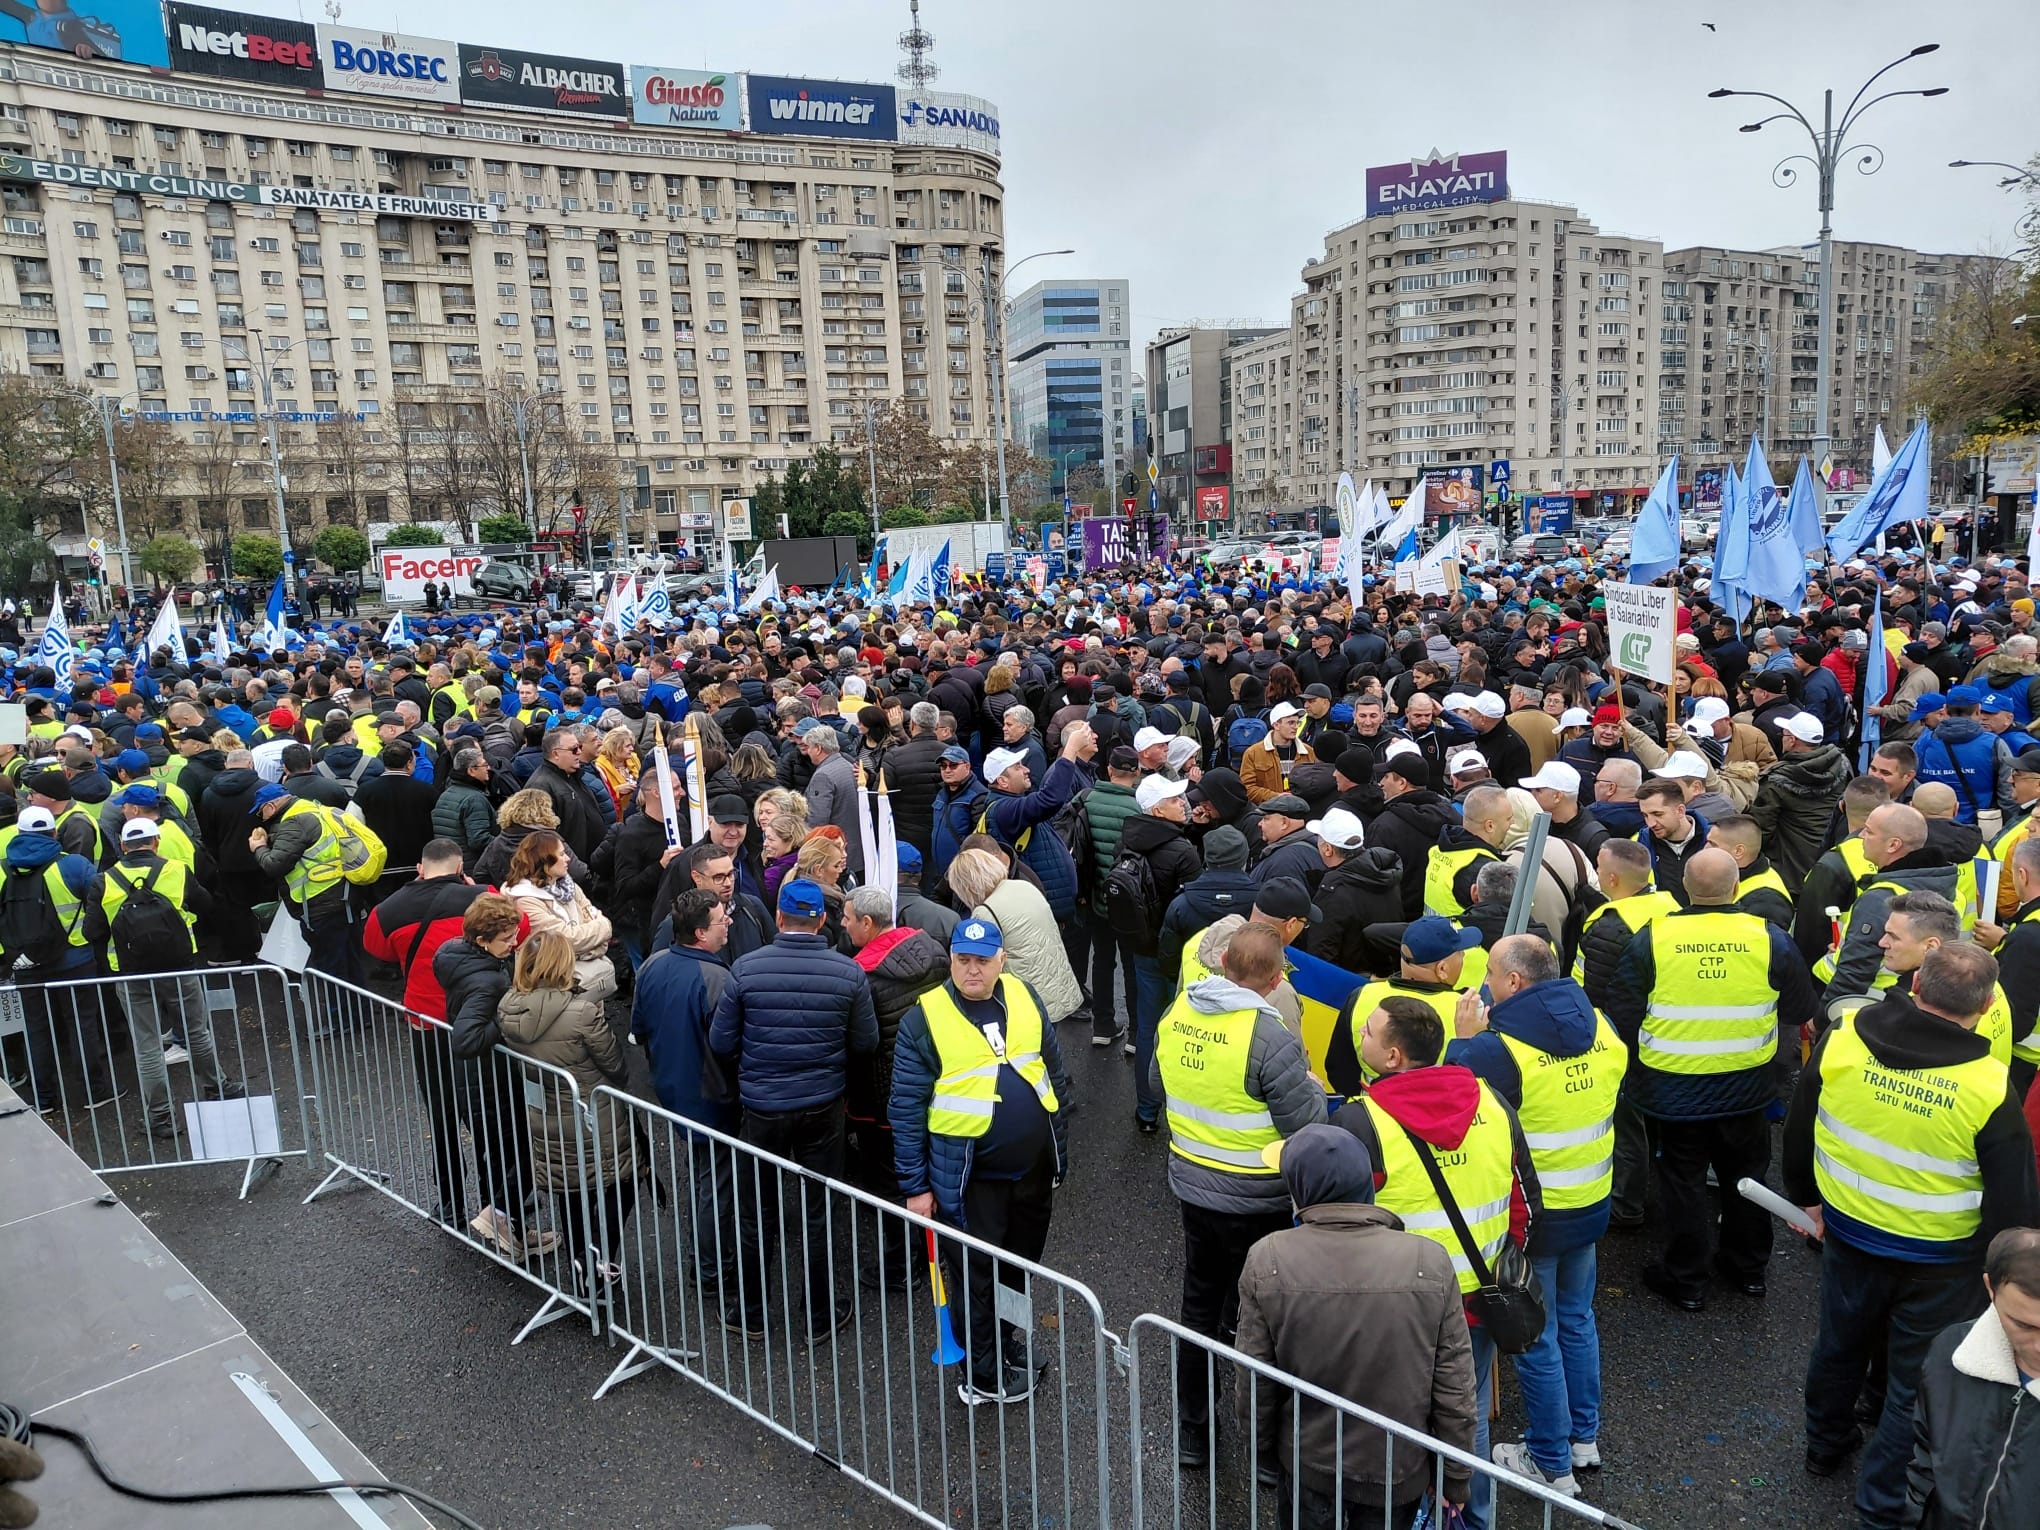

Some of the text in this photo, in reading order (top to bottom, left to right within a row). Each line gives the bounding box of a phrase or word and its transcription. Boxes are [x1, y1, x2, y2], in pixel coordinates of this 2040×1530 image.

[179, 23, 313, 67] NetBet
[332, 40, 448, 82] BORSEC
[520, 62, 620, 97] ALBACHER
[554, 84, 602, 107] Premium
[645, 76, 724, 107] Giusto
[669, 106, 720, 122] Natura
[770, 90, 874, 125] winner
[926, 106, 1000, 139] SANADOR
[32, 161, 246, 199] EDENT CLINIC
[1379, 171, 1494, 202] ENAYATI
[271, 188, 373, 210] SĂNĂTATEA
[378, 196, 387, 210] E
[1393, 195, 1479, 213] MEDICAL CITY
[209, 412, 256, 422] OLIMPIC
[383, 553, 482, 580] Facem
[1605, 584, 1666, 610] Sindicatul Liber
[1610, 606, 1616, 620] al
[1675, 943, 1750, 953] SINDICATUL
[1700, 957, 1724, 966] CTP
[1697, 969, 1726, 979] CLUJ
[1173, 1021, 1229, 1045] SINDICATUL
[1184, 1041, 1203, 1055] CTP
[1180, 1056, 1205, 1070] CLUJ
[1565, 1062, 1589, 1077] CTP
[1565, 1077, 1594, 1094] CLUJ
[1863, 1069, 1955, 1110] TRANSURBAN
[1927, 1074, 1959, 1093] LIBER
[1874, 1091, 1934, 1118] SATU MARE
[1435, 1153, 1467, 1169] CLUJ
